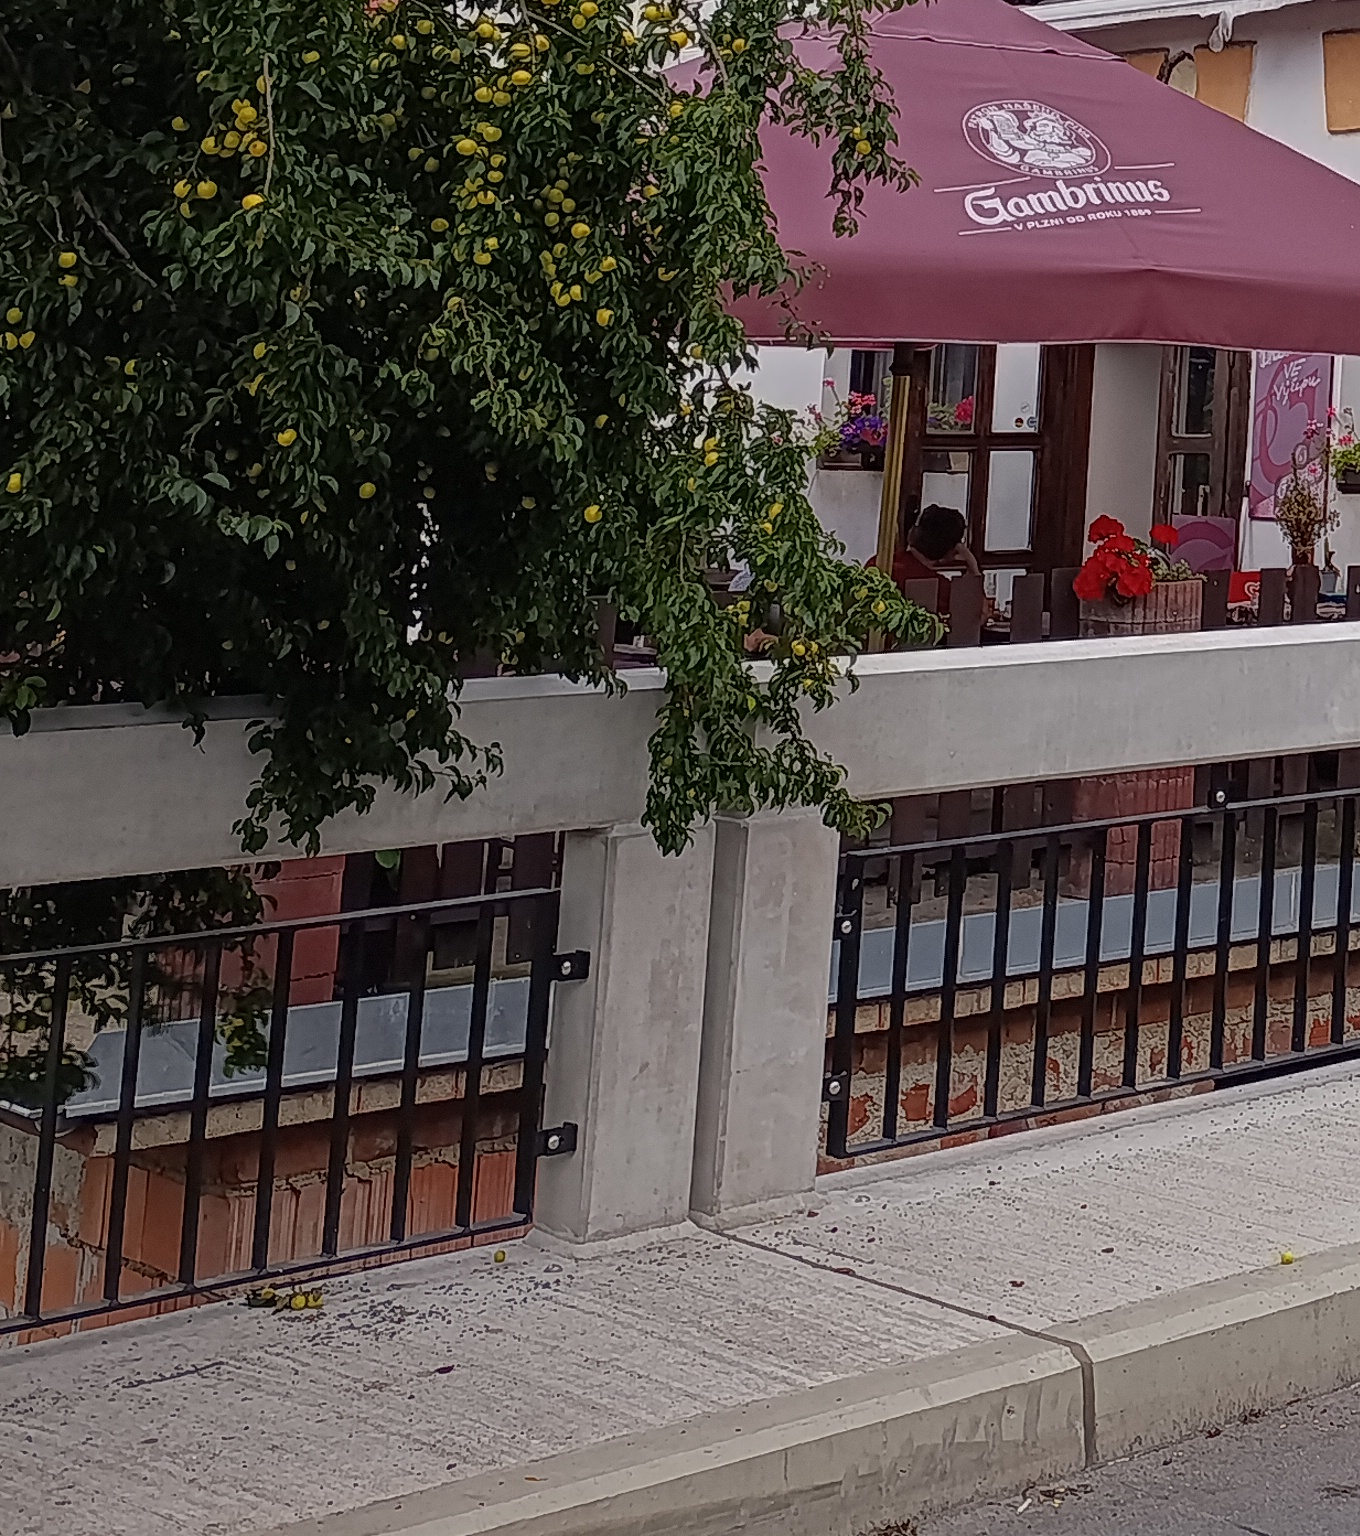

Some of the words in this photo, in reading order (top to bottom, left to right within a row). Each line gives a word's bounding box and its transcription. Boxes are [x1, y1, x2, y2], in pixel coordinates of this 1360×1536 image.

[1019, 164, 1099, 177] GAMBRINUS
[964, 176, 1171, 225] Gambrinus
[1014, 222, 1024, 232] V
[1026, 217, 1065, 231] PLZNI
[1066, 215, 1087, 226] OD
[1088, 209, 1122, 223] ROKU
[1283, 357, 1307, 379] VE
